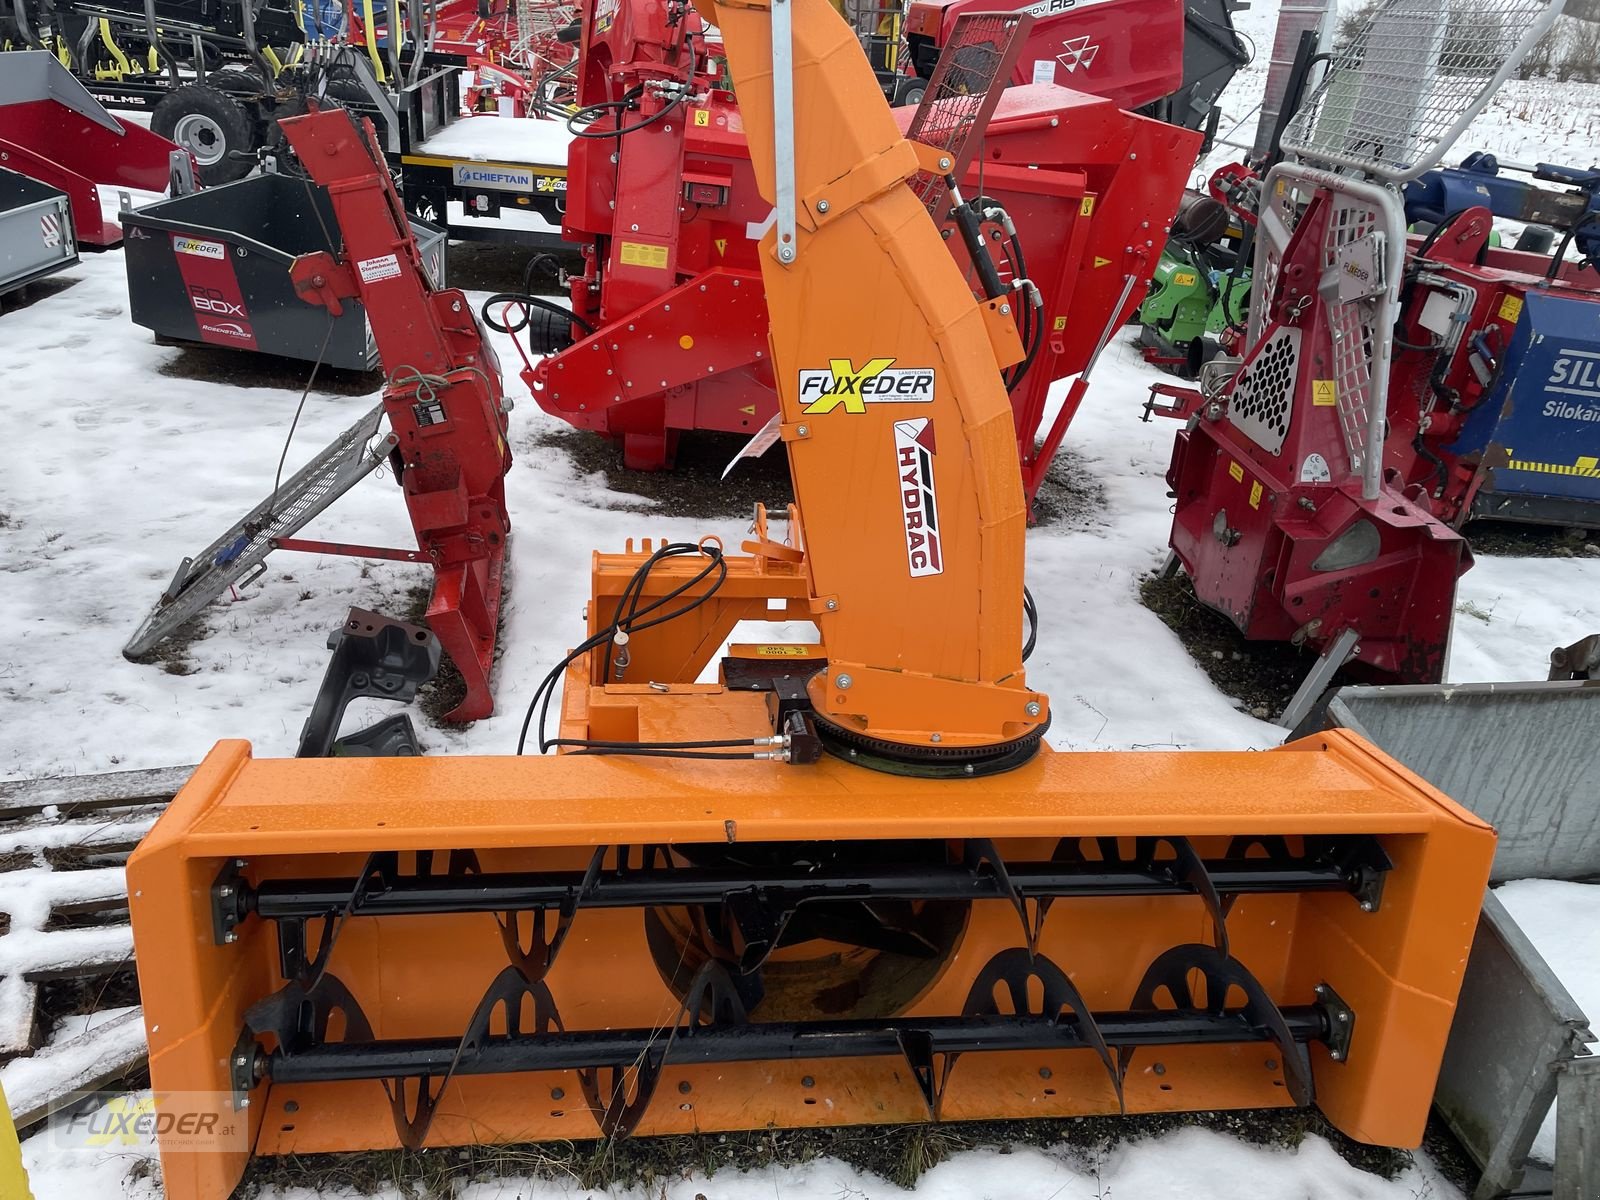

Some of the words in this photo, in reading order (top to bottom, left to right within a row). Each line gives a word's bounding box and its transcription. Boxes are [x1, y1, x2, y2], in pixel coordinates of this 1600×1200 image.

[1050, 0, 1076, 11] RB
[472, 171, 529, 185] CHIEFTAIN
[176, 240, 218, 254] FLIXEDER
[1343, 262, 1368, 281] FLIXEDER
[192, 296, 245, 317] BOX
[1548, 358, 1600, 389] SIL
[801, 375, 933, 395] FLIXEDER
[899, 446, 928, 570] HYDRAC
